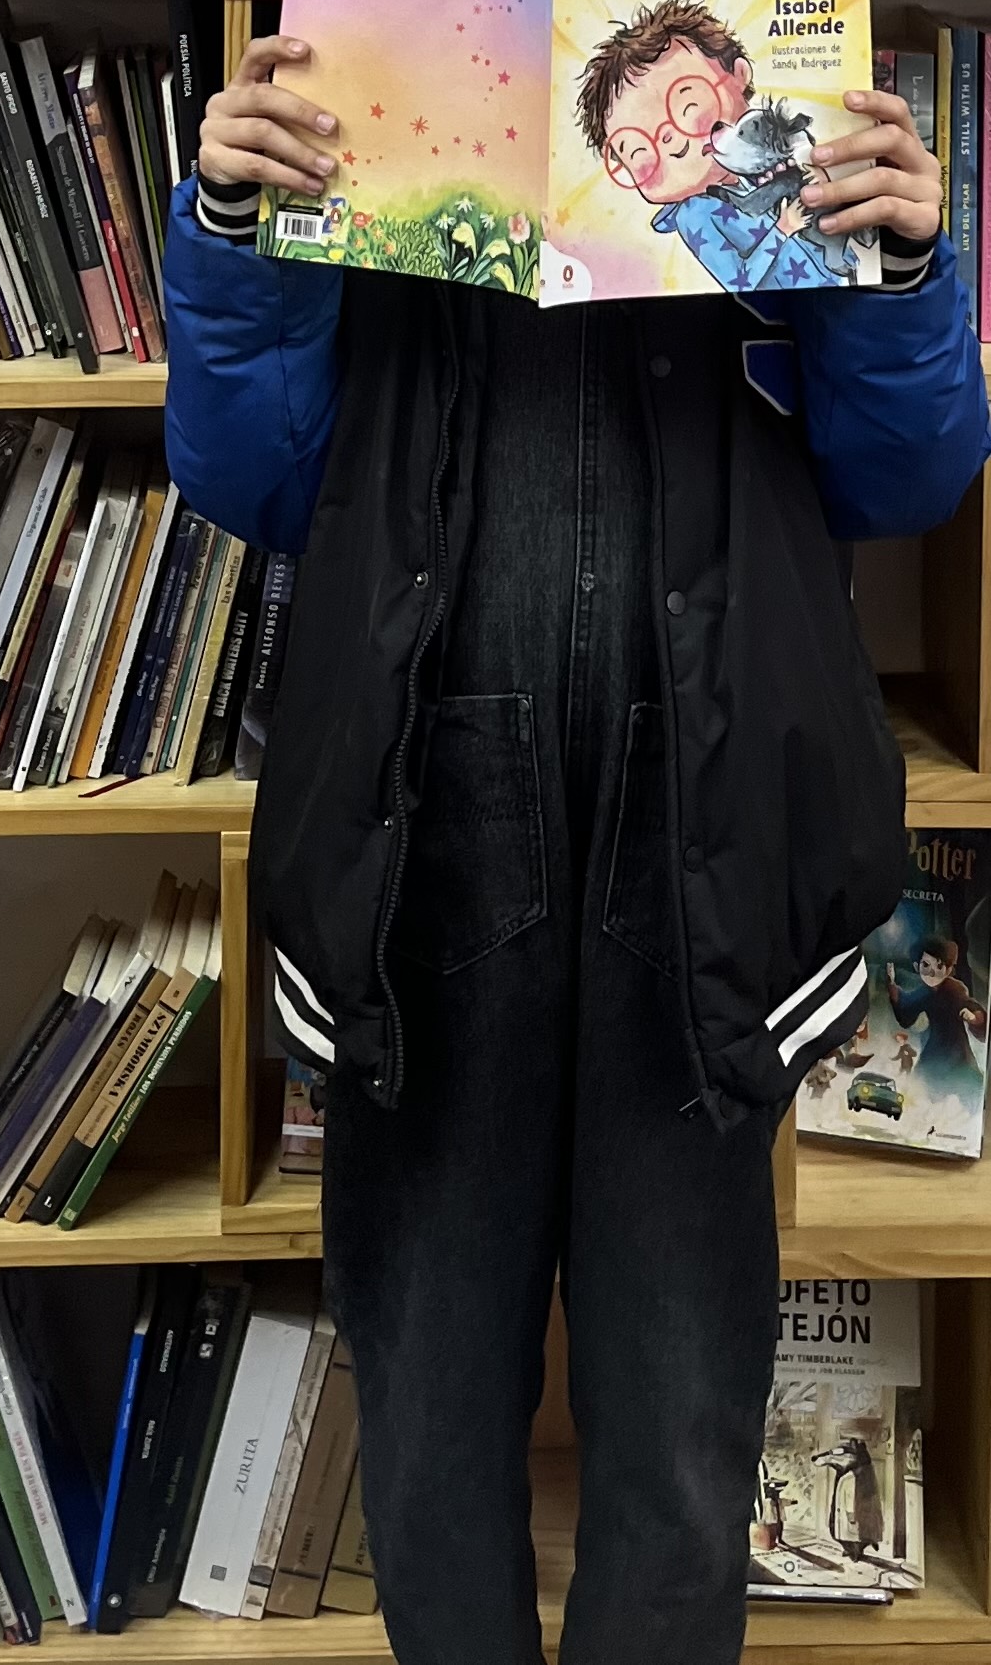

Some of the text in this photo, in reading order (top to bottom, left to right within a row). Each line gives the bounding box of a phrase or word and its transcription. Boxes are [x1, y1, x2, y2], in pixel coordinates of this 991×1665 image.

[768, 18, 845, 37] Allende
[771, 44, 841, 56] Ilustraciones de
[771, 56, 842, 72] Sandy Rodríguez
[260, 562, 287, 655] ALFONSO REYES
[211, 610, 250, 717] BLACK WATERS CITY
[902, 889, 944, 902] SECRETA
[779, 1279, 871, 1306] OFETO
[779, 1307, 870, 1344] TEJÓN
[797, 1354, 853, 1365] TIMBERLAKE
[234, 1437, 260, 1495] ZURITA
